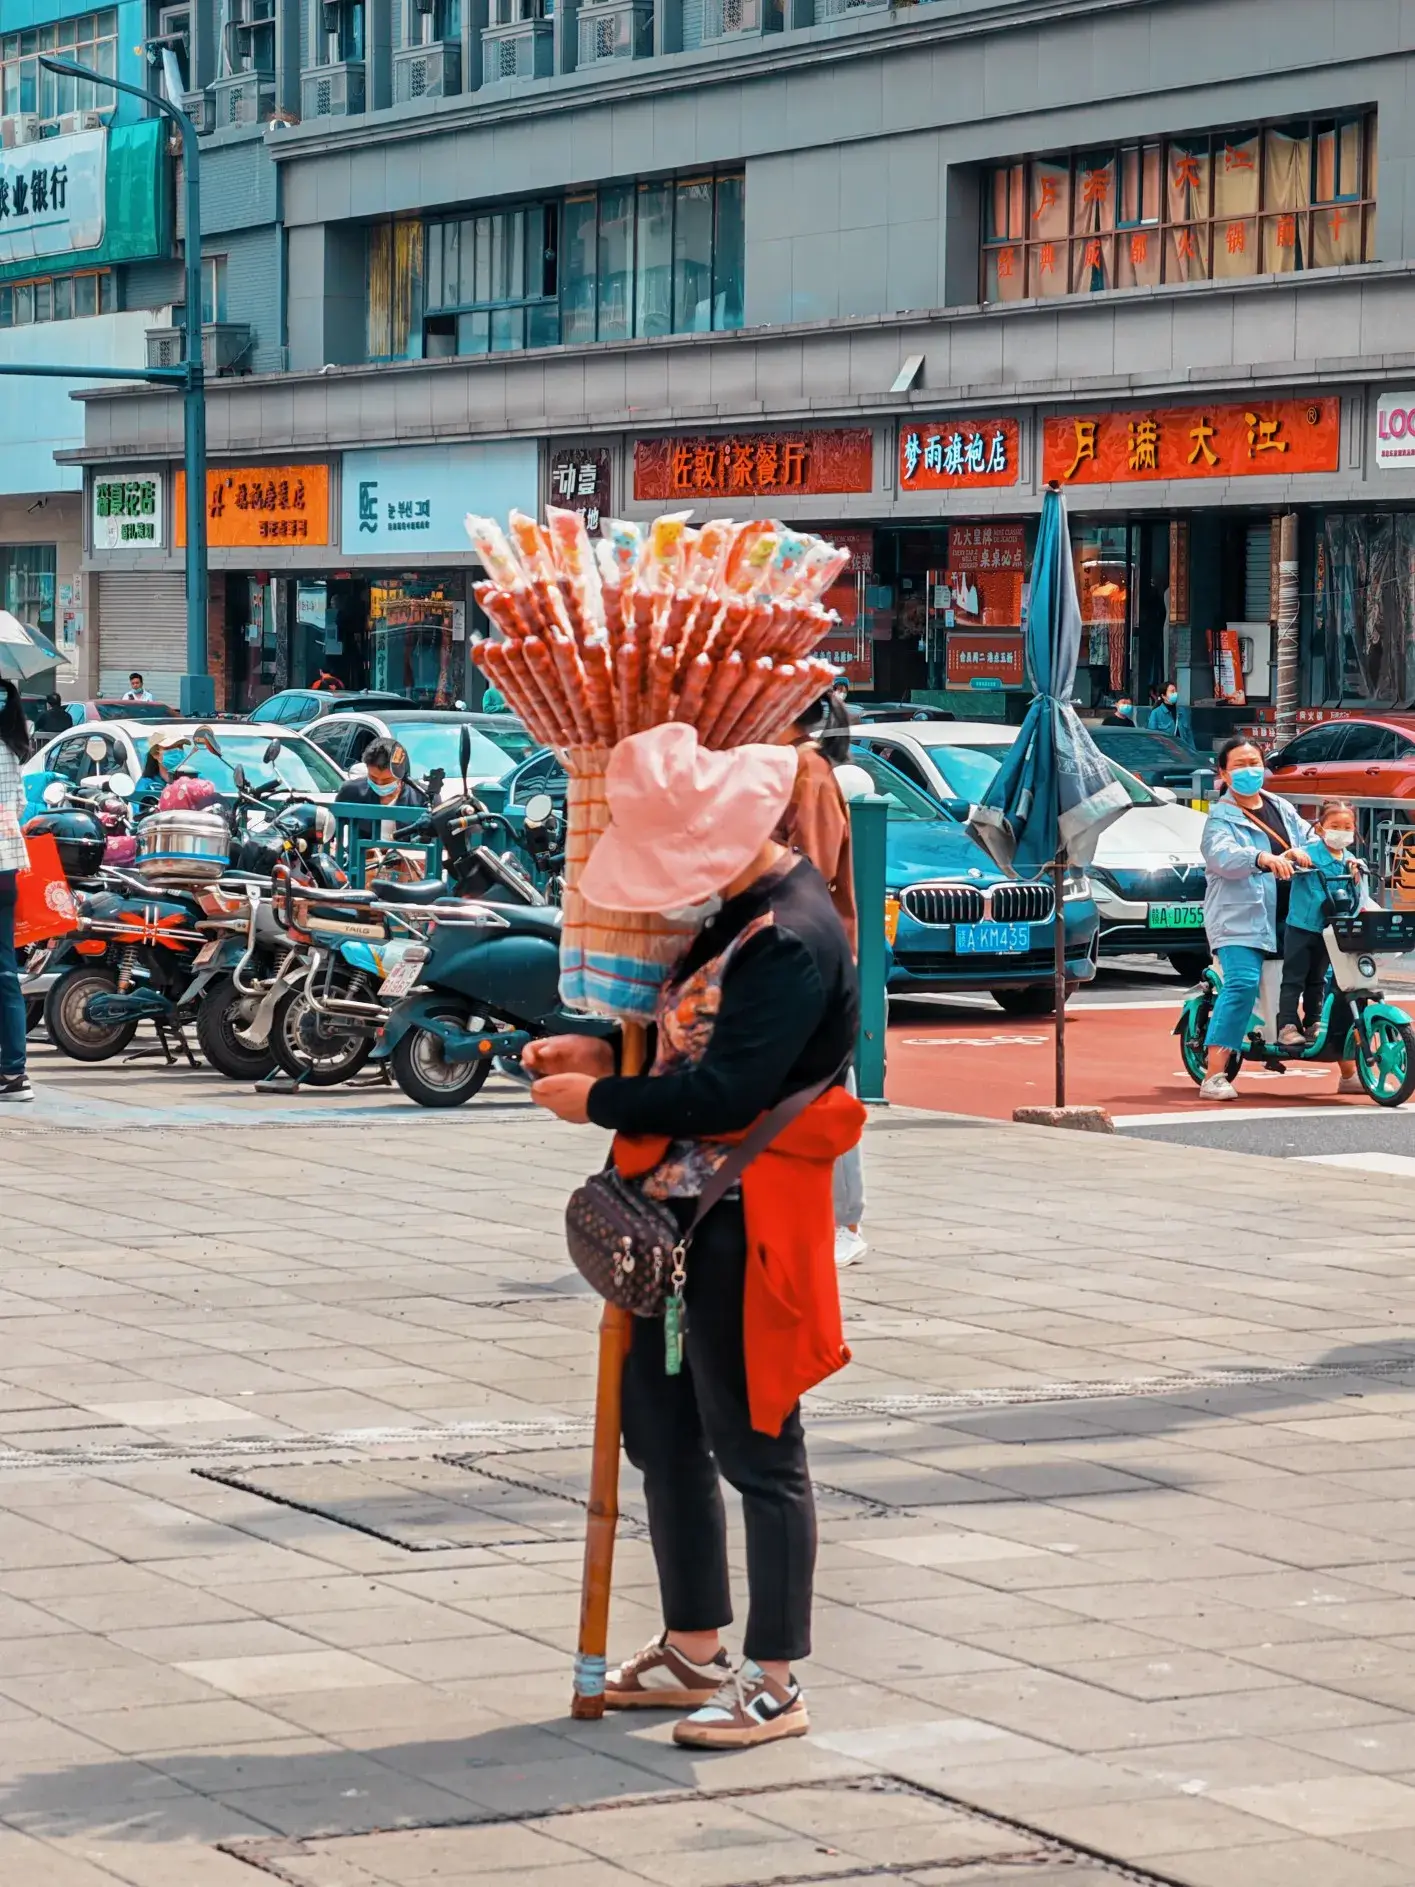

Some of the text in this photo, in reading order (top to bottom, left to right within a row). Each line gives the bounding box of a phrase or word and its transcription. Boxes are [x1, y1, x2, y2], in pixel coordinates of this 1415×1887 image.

[904, 430, 1006, 480] 梦雨旗袍店
[953, 528, 992, 546] 九大皇牌
[980, 547, 1023, 568] 桌桌必点
